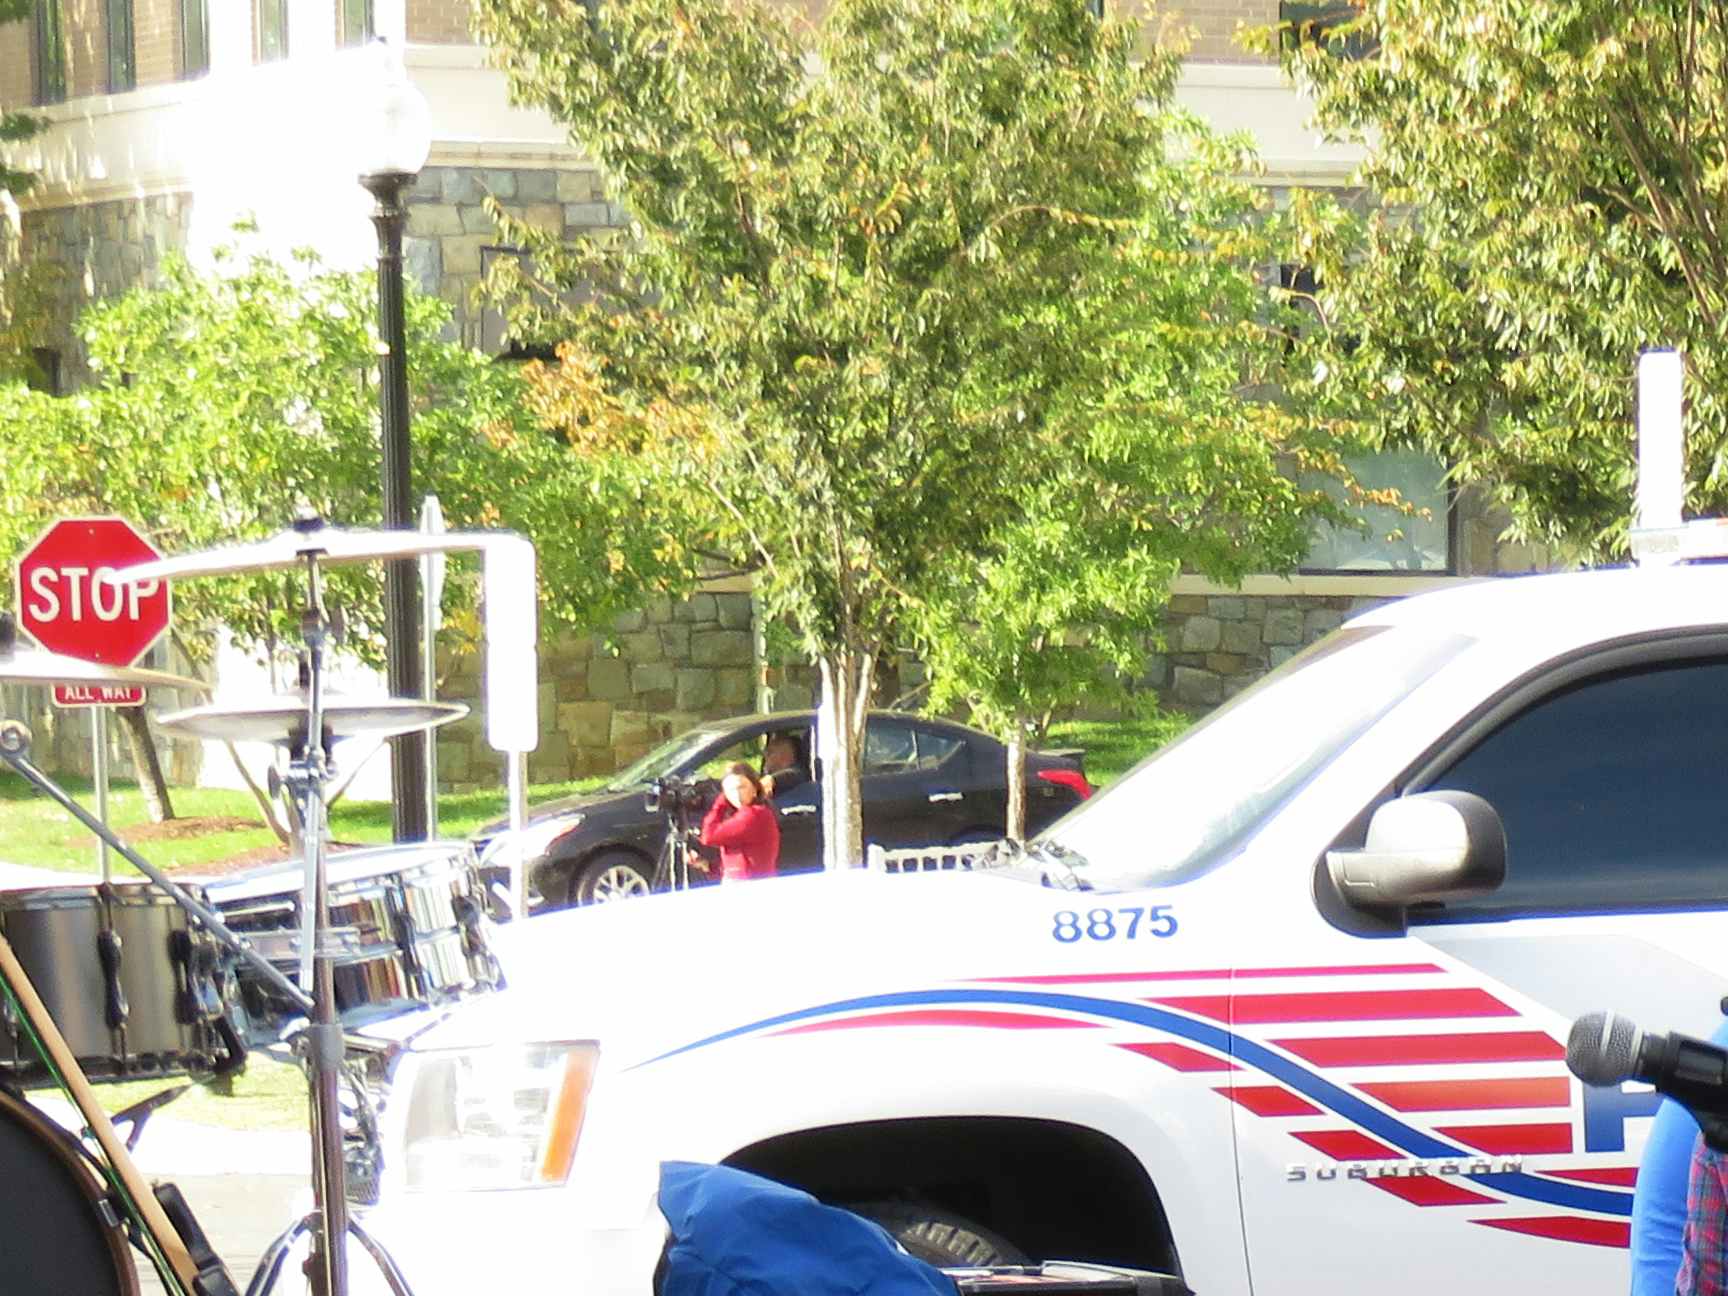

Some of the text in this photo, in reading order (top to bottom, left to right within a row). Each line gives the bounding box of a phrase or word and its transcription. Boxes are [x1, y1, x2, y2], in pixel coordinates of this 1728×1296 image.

[29, 566, 159, 622] STOP
[64, 685, 133, 700] ALL WAY
[1052, 904, 1179, 943] 8875
[1286, 1155, 1523, 1182] SUBURBAN
